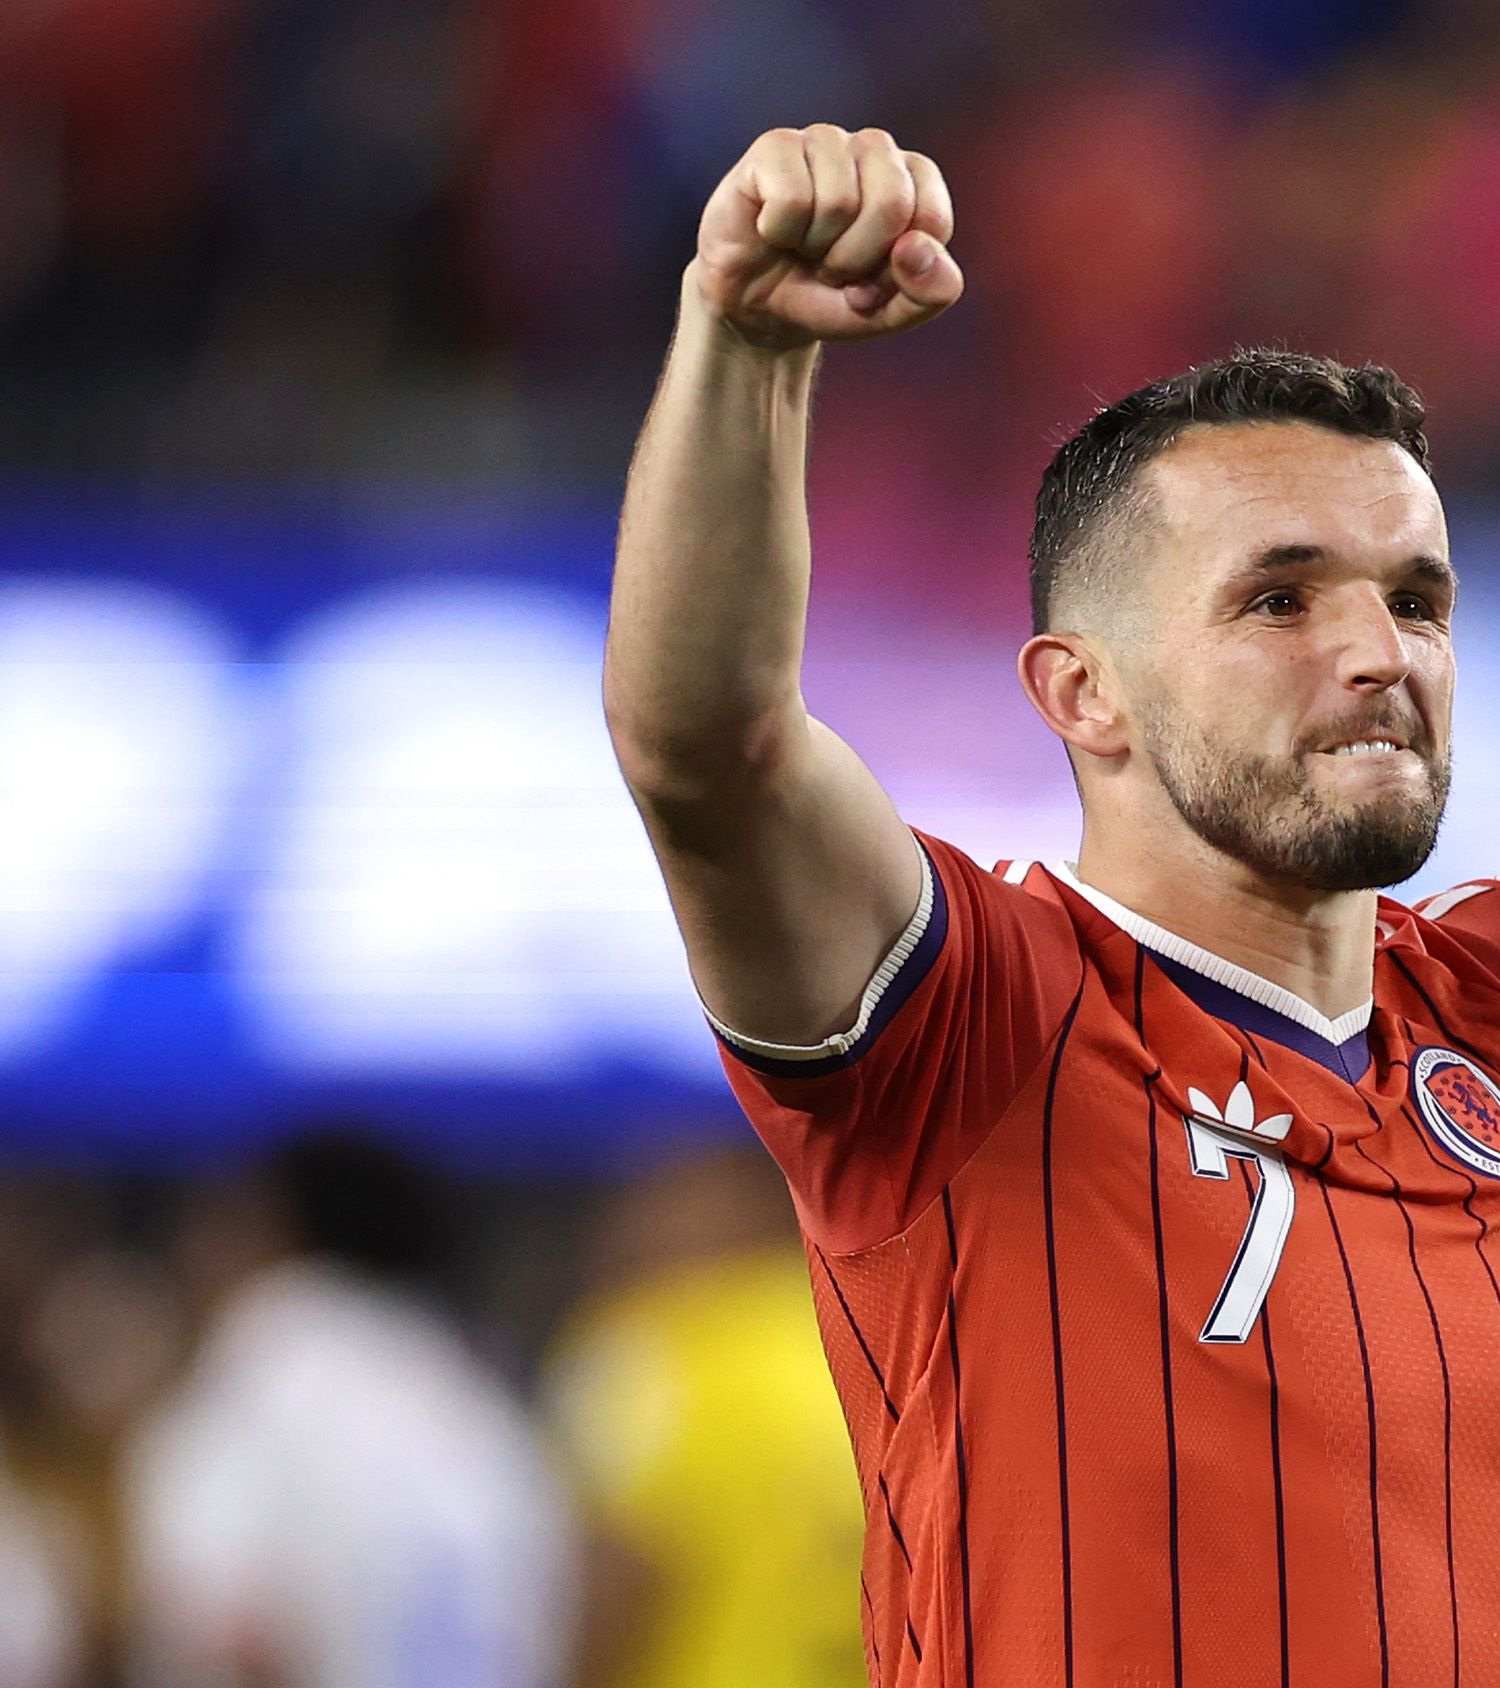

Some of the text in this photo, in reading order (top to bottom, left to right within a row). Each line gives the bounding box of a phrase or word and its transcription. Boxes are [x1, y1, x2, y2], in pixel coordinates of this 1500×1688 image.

[1418, 1052, 1457, 1075] SCOTLAND
[1482, 1159, 1500, 1173] EST
[1181, 1114, 1296, 1343] 7
